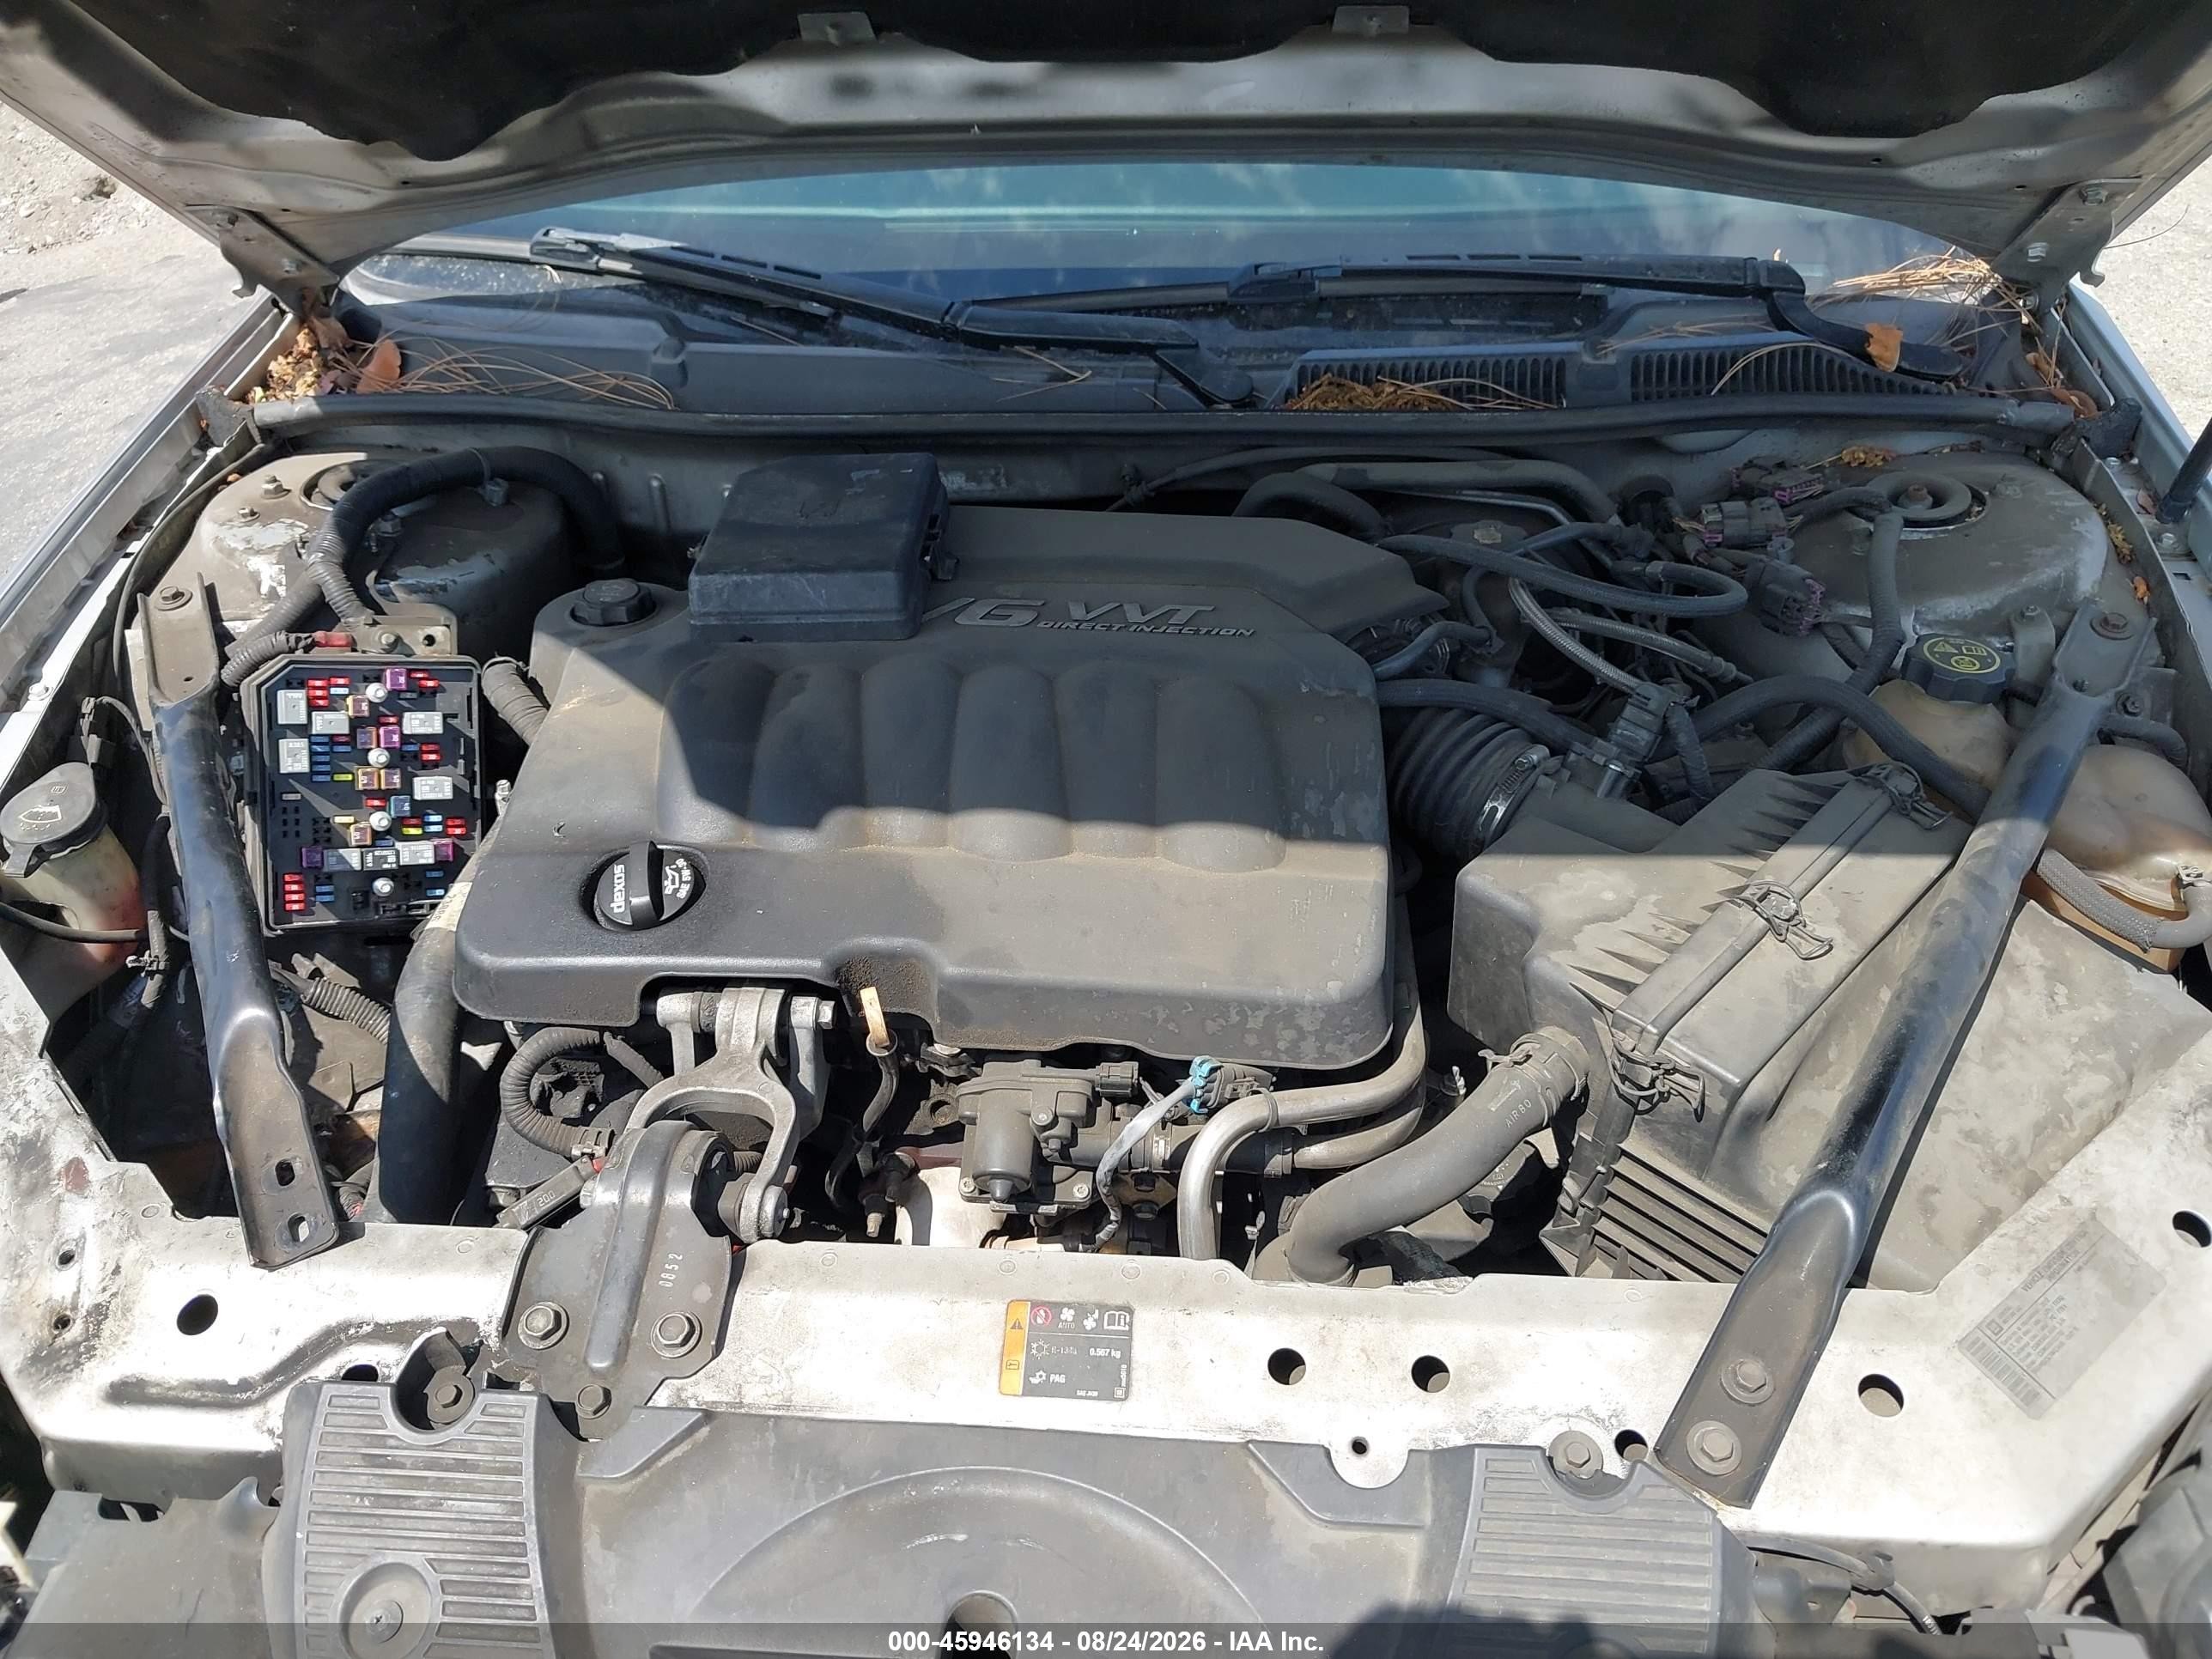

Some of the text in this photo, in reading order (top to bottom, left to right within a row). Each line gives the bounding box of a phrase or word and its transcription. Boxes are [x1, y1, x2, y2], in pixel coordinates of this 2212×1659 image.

[1069, 601, 1215, 625] VVT
[1036, 620, 1256, 637] DIRECT INJECTION
[676, 858, 691, 899] SAE 5W-30
[610, 864, 625, 914] dexos
[536, 1190, 556, 1207] 200
[658, 1253, 684, 1288] 0852
[1110, 1348, 1121, 1359] kg
[1049, 1373, 1066, 1384] PAG
